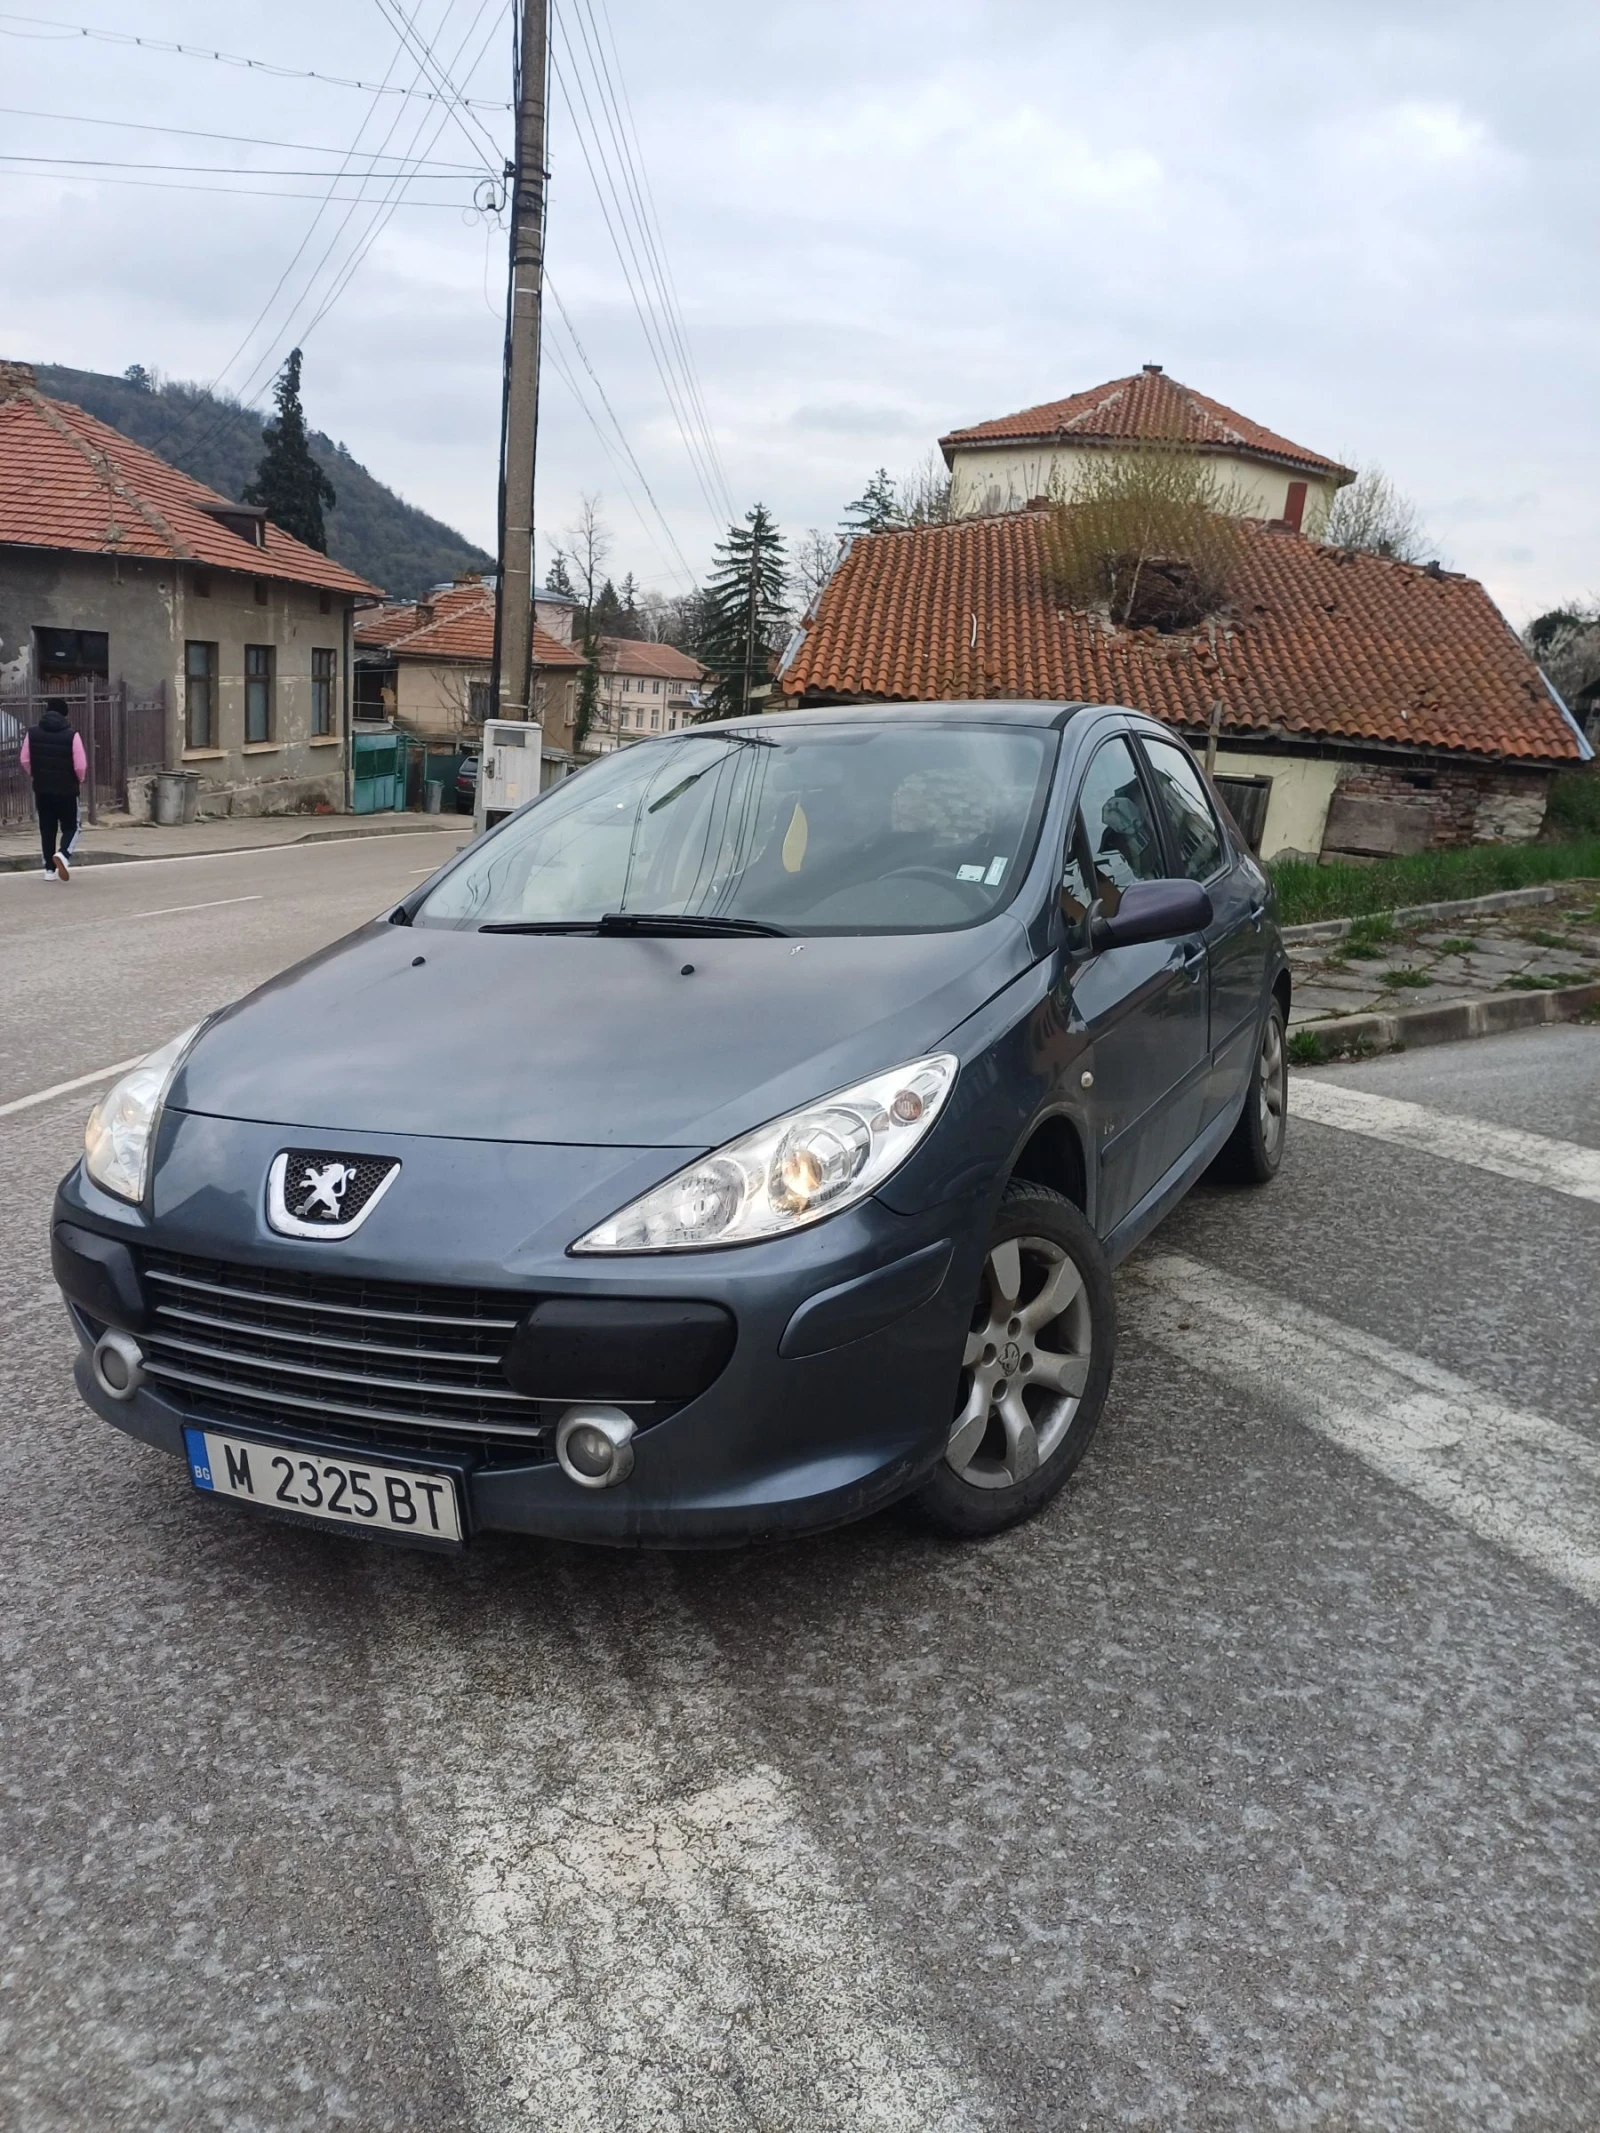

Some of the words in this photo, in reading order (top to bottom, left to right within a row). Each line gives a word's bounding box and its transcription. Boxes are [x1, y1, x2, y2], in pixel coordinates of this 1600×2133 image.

[194, 1465, 210, 1480] BG
[223, 1444, 254, 1495] M
[271, 1456, 378, 1518] 2325
[385, 1475, 443, 1530] BT
